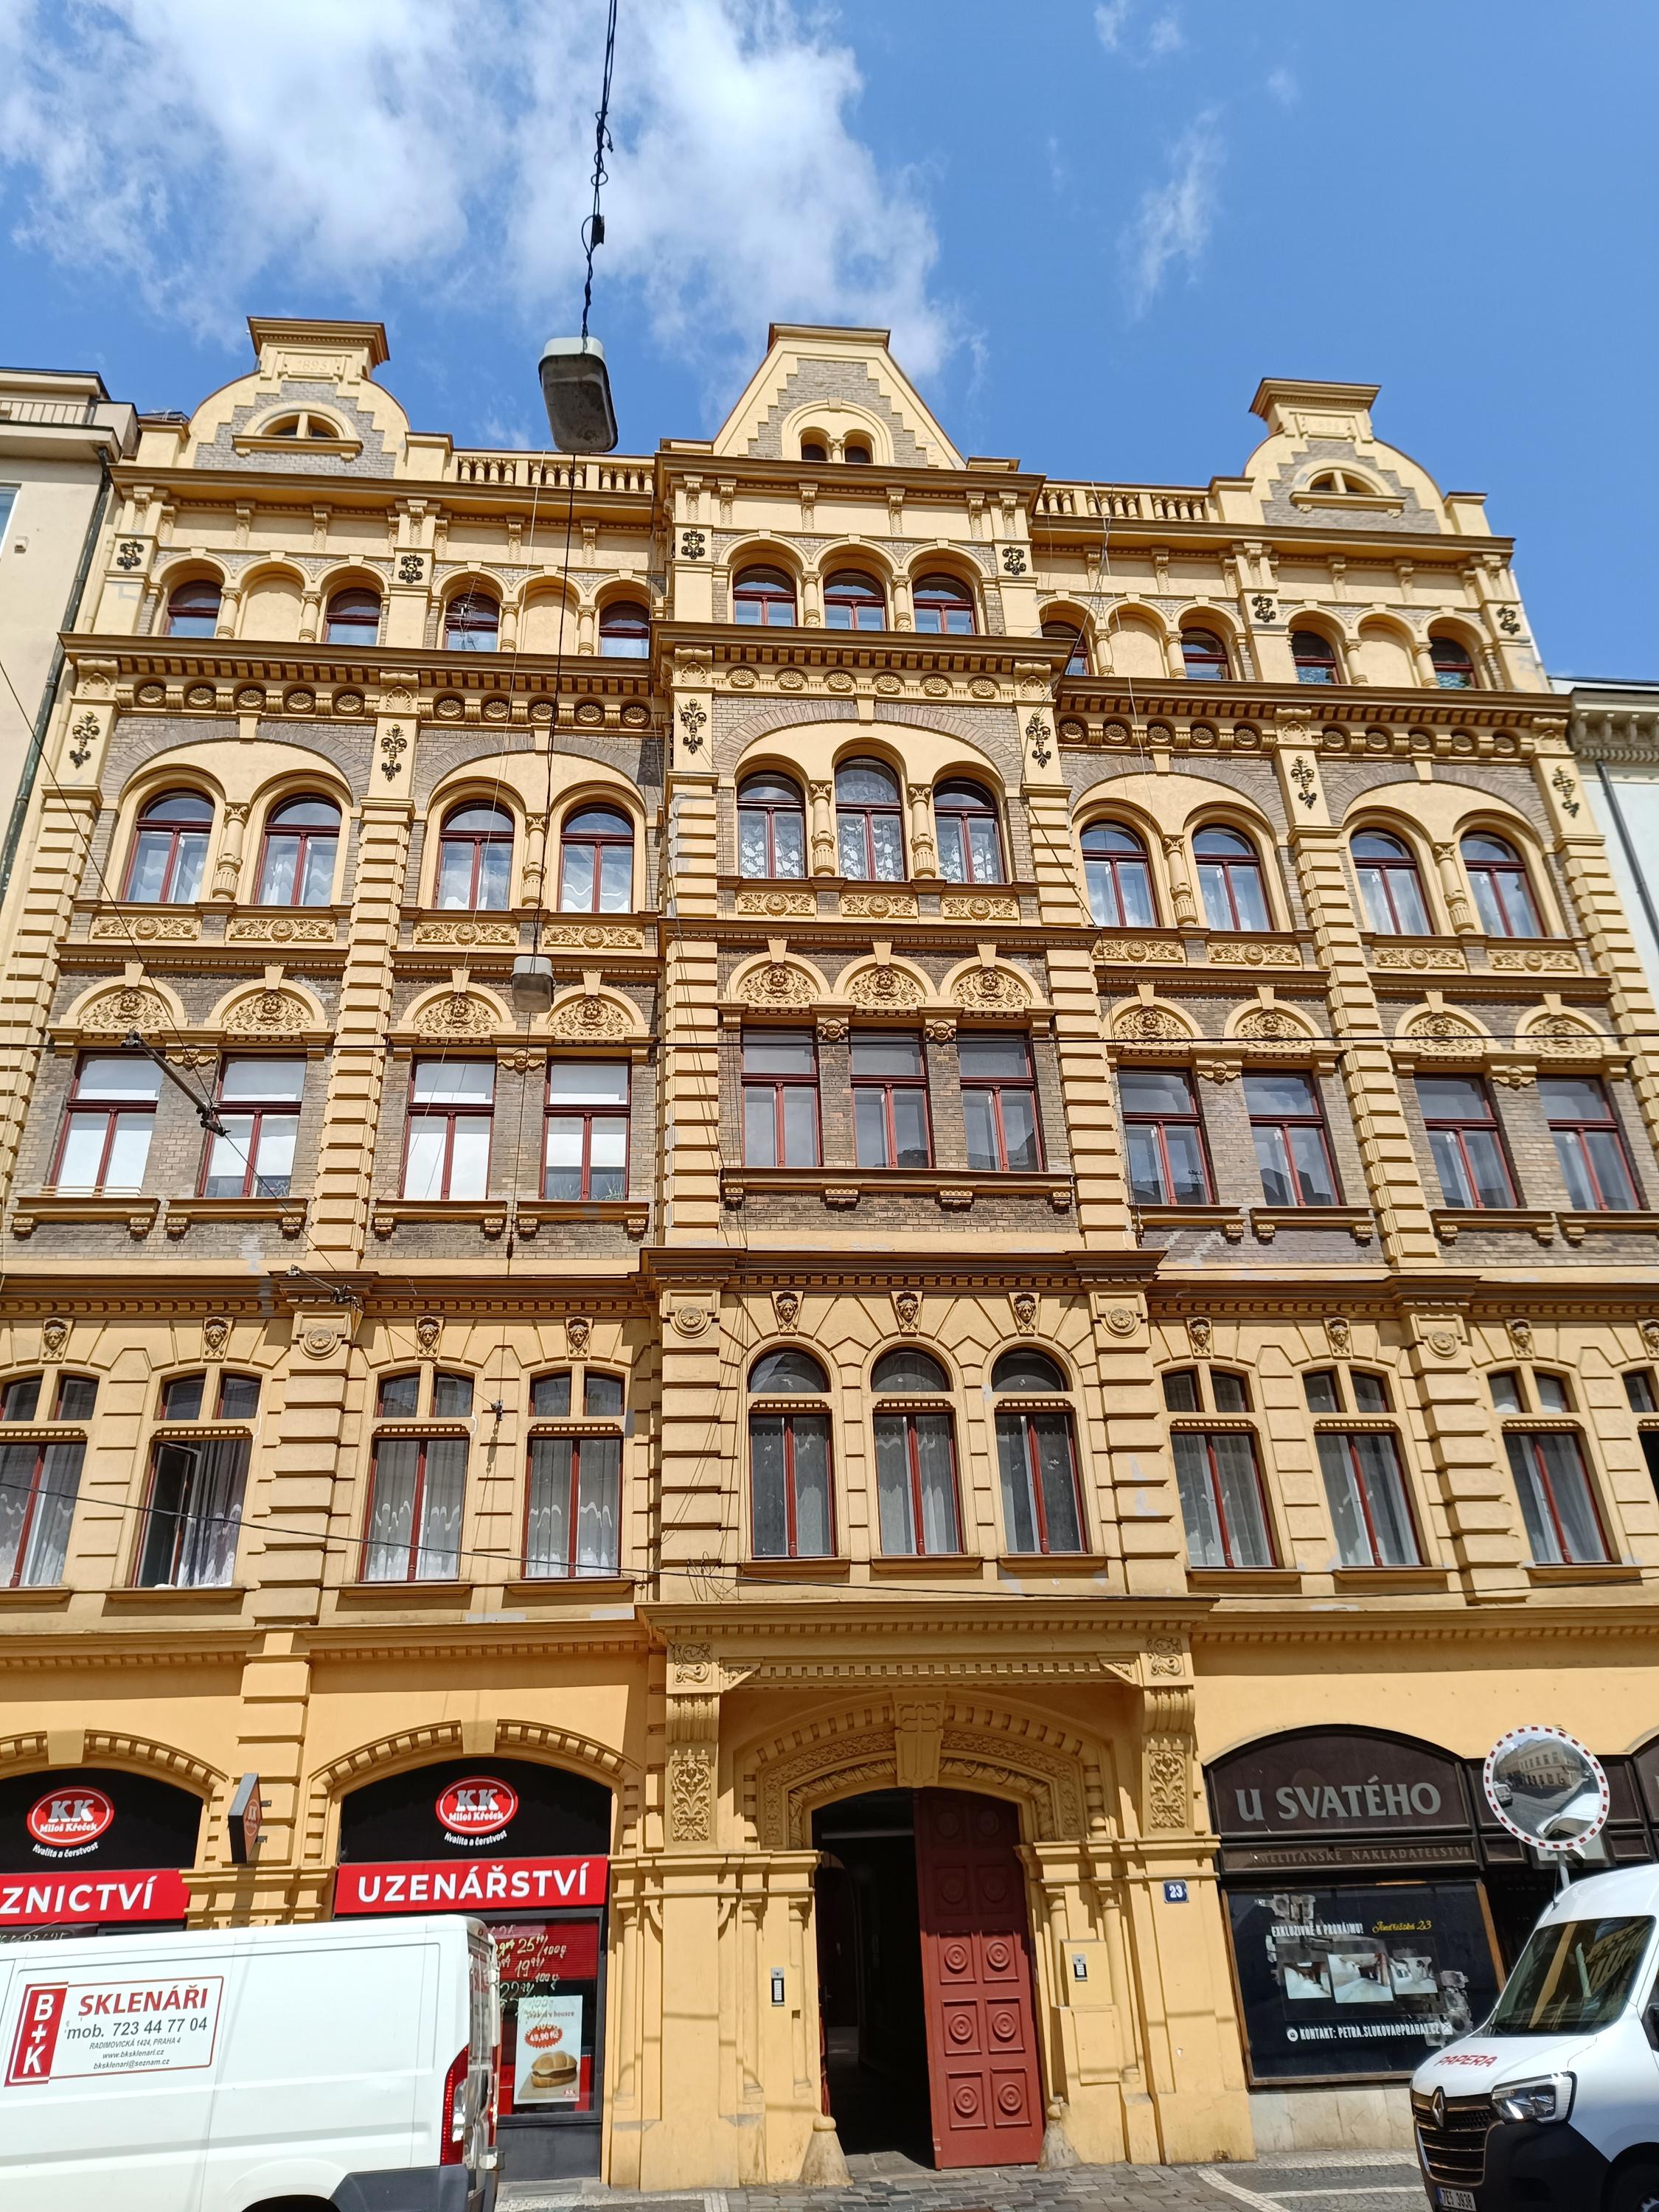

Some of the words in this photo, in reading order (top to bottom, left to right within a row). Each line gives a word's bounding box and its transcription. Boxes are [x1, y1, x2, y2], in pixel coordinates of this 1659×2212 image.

[455, 1789, 499, 1812] KK
[1234, 1788, 1265, 1822] U
[1275, 1774, 1442, 1820] SVATÉHO
[48, 1799, 94, 1823] KK
[444, 1832, 468, 1846] Kvalita
[469, 1838, 474, 1846] a
[475, 1829, 507, 1846] čerstvost
[32, 1843, 57, 1857] Kvalita
[64, 1842, 99, 1857] čerstvost
[358, 1862, 590, 1903] UZENÁŘSTVÍ
[0, 1875, 157, 1914] ZNICTVÍ
[1169, 1885, 1183, 1898] 23
[1416, 1920, 1432, 1931] 23
[78, 1984, 209, 2016] SKLENÁŘI
[66, 2024, 105, 2039] mob.
[113, 2021, 139, 2037] 723
[144, 2020, 162, 2034] 44
[167, 2018, 186, 2033] 77
[189, 2017, 208, 2031] 04
[1300, 2028, 1338, 2040] KONTAKT:
[89, 2039, 135, 2050] RADIMOVICKÁ
[153, 2037, 176, 2045] PRAHA
[102, 2049, 165, 2059] www.bksklenari.cz
[1433, 2055, 1498, 2067] PAPERA
[93, 2059, 170, 2070] bksklenari@seznam.cz
